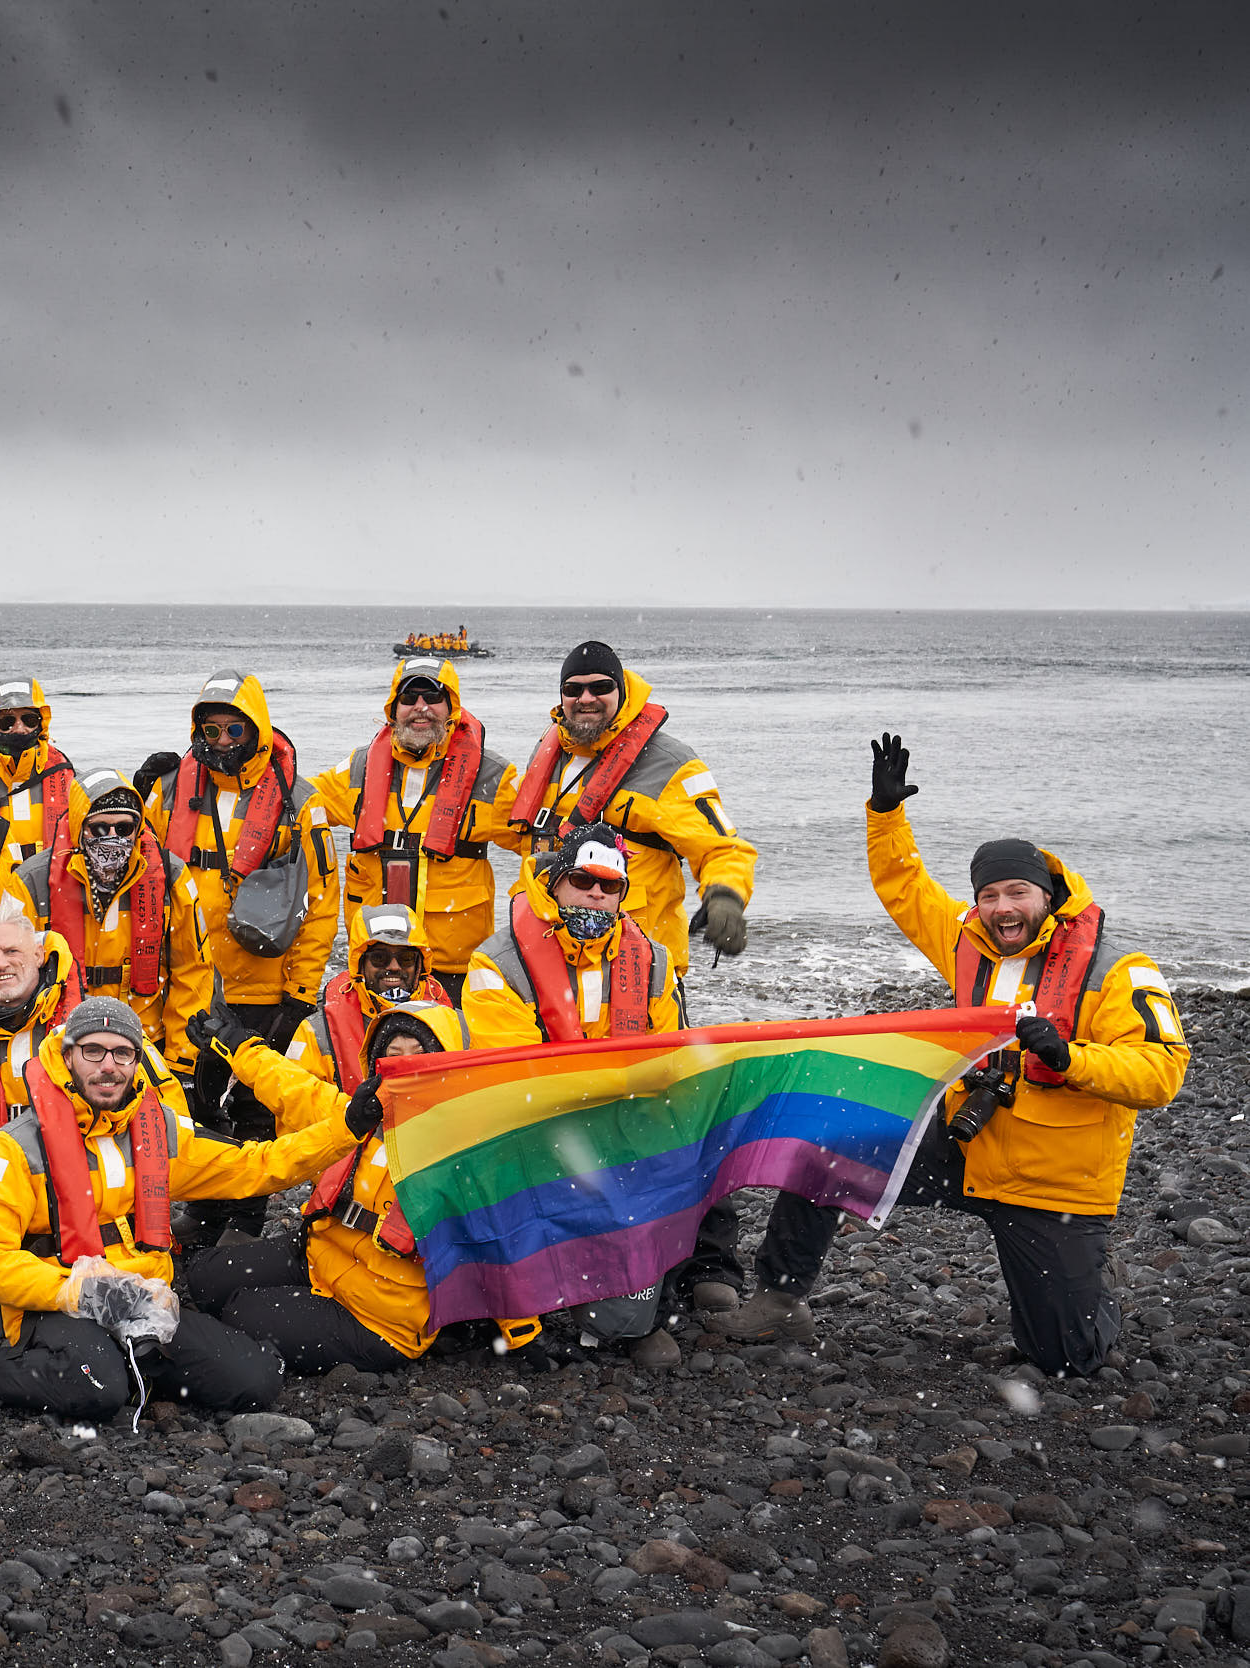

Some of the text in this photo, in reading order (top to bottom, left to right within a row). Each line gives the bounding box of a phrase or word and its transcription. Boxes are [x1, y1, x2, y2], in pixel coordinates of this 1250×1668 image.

[138, 884, 146, 923] CE275N
[619, 949, 628, 993] CE275N
[1041, 952, 1059, 996] CE275N
[139, 1111, 151, 1158] CE275N
